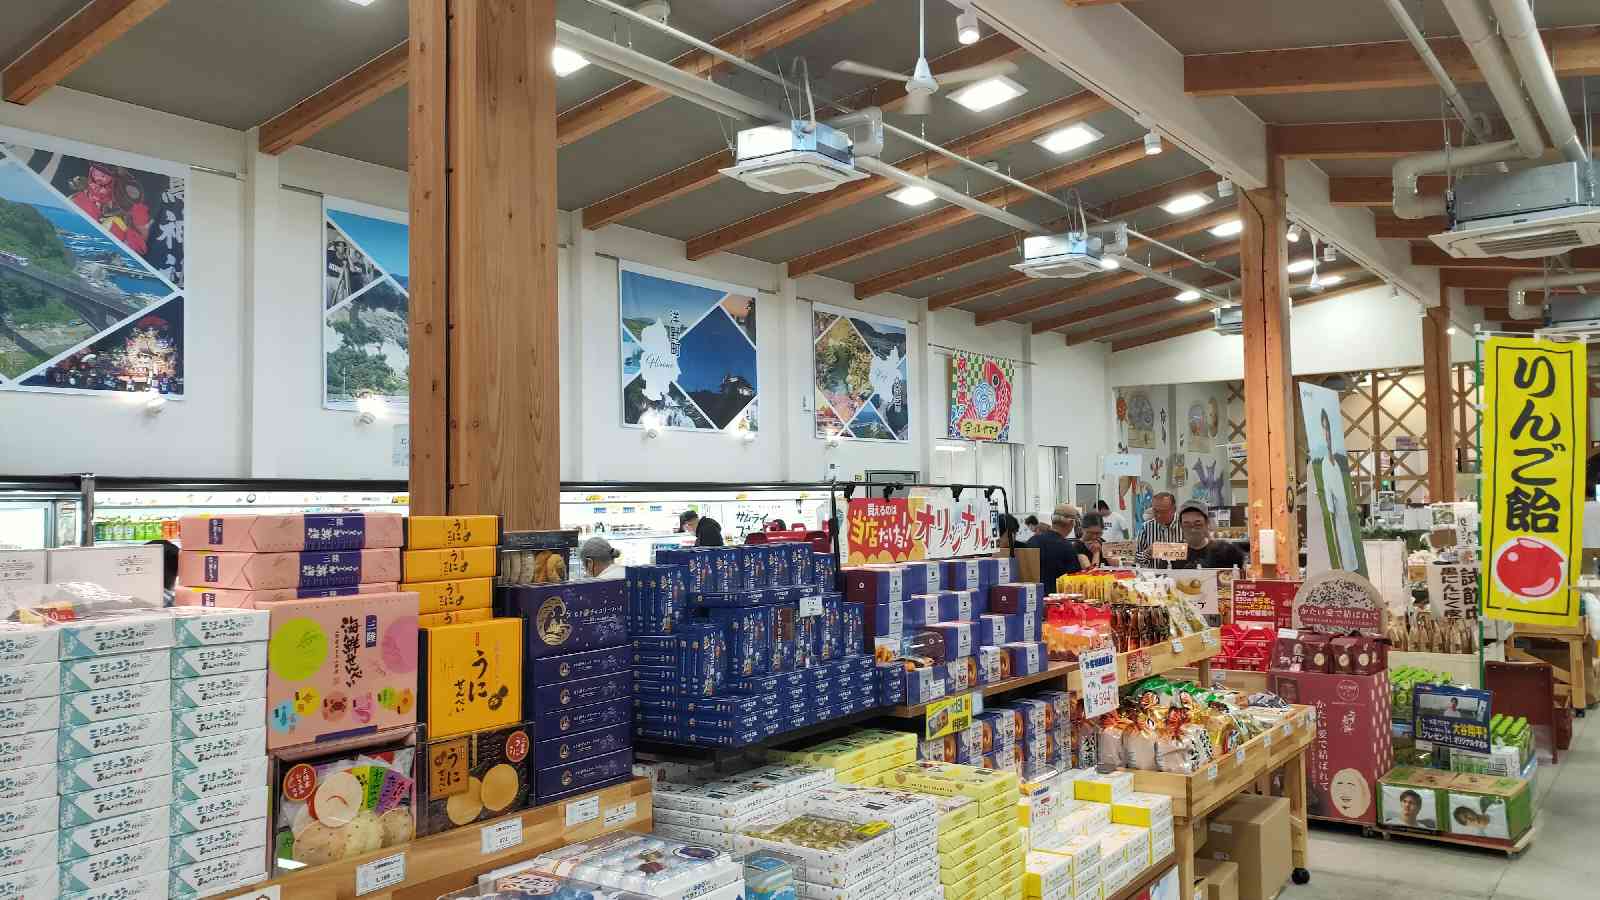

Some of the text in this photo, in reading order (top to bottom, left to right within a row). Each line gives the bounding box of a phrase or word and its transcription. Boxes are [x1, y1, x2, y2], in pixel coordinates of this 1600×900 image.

[1506, 354, 1566, 533] りんご飴
[867, 503, 897, 517] 買えるのは
[467, 649, 489, 703] うに
